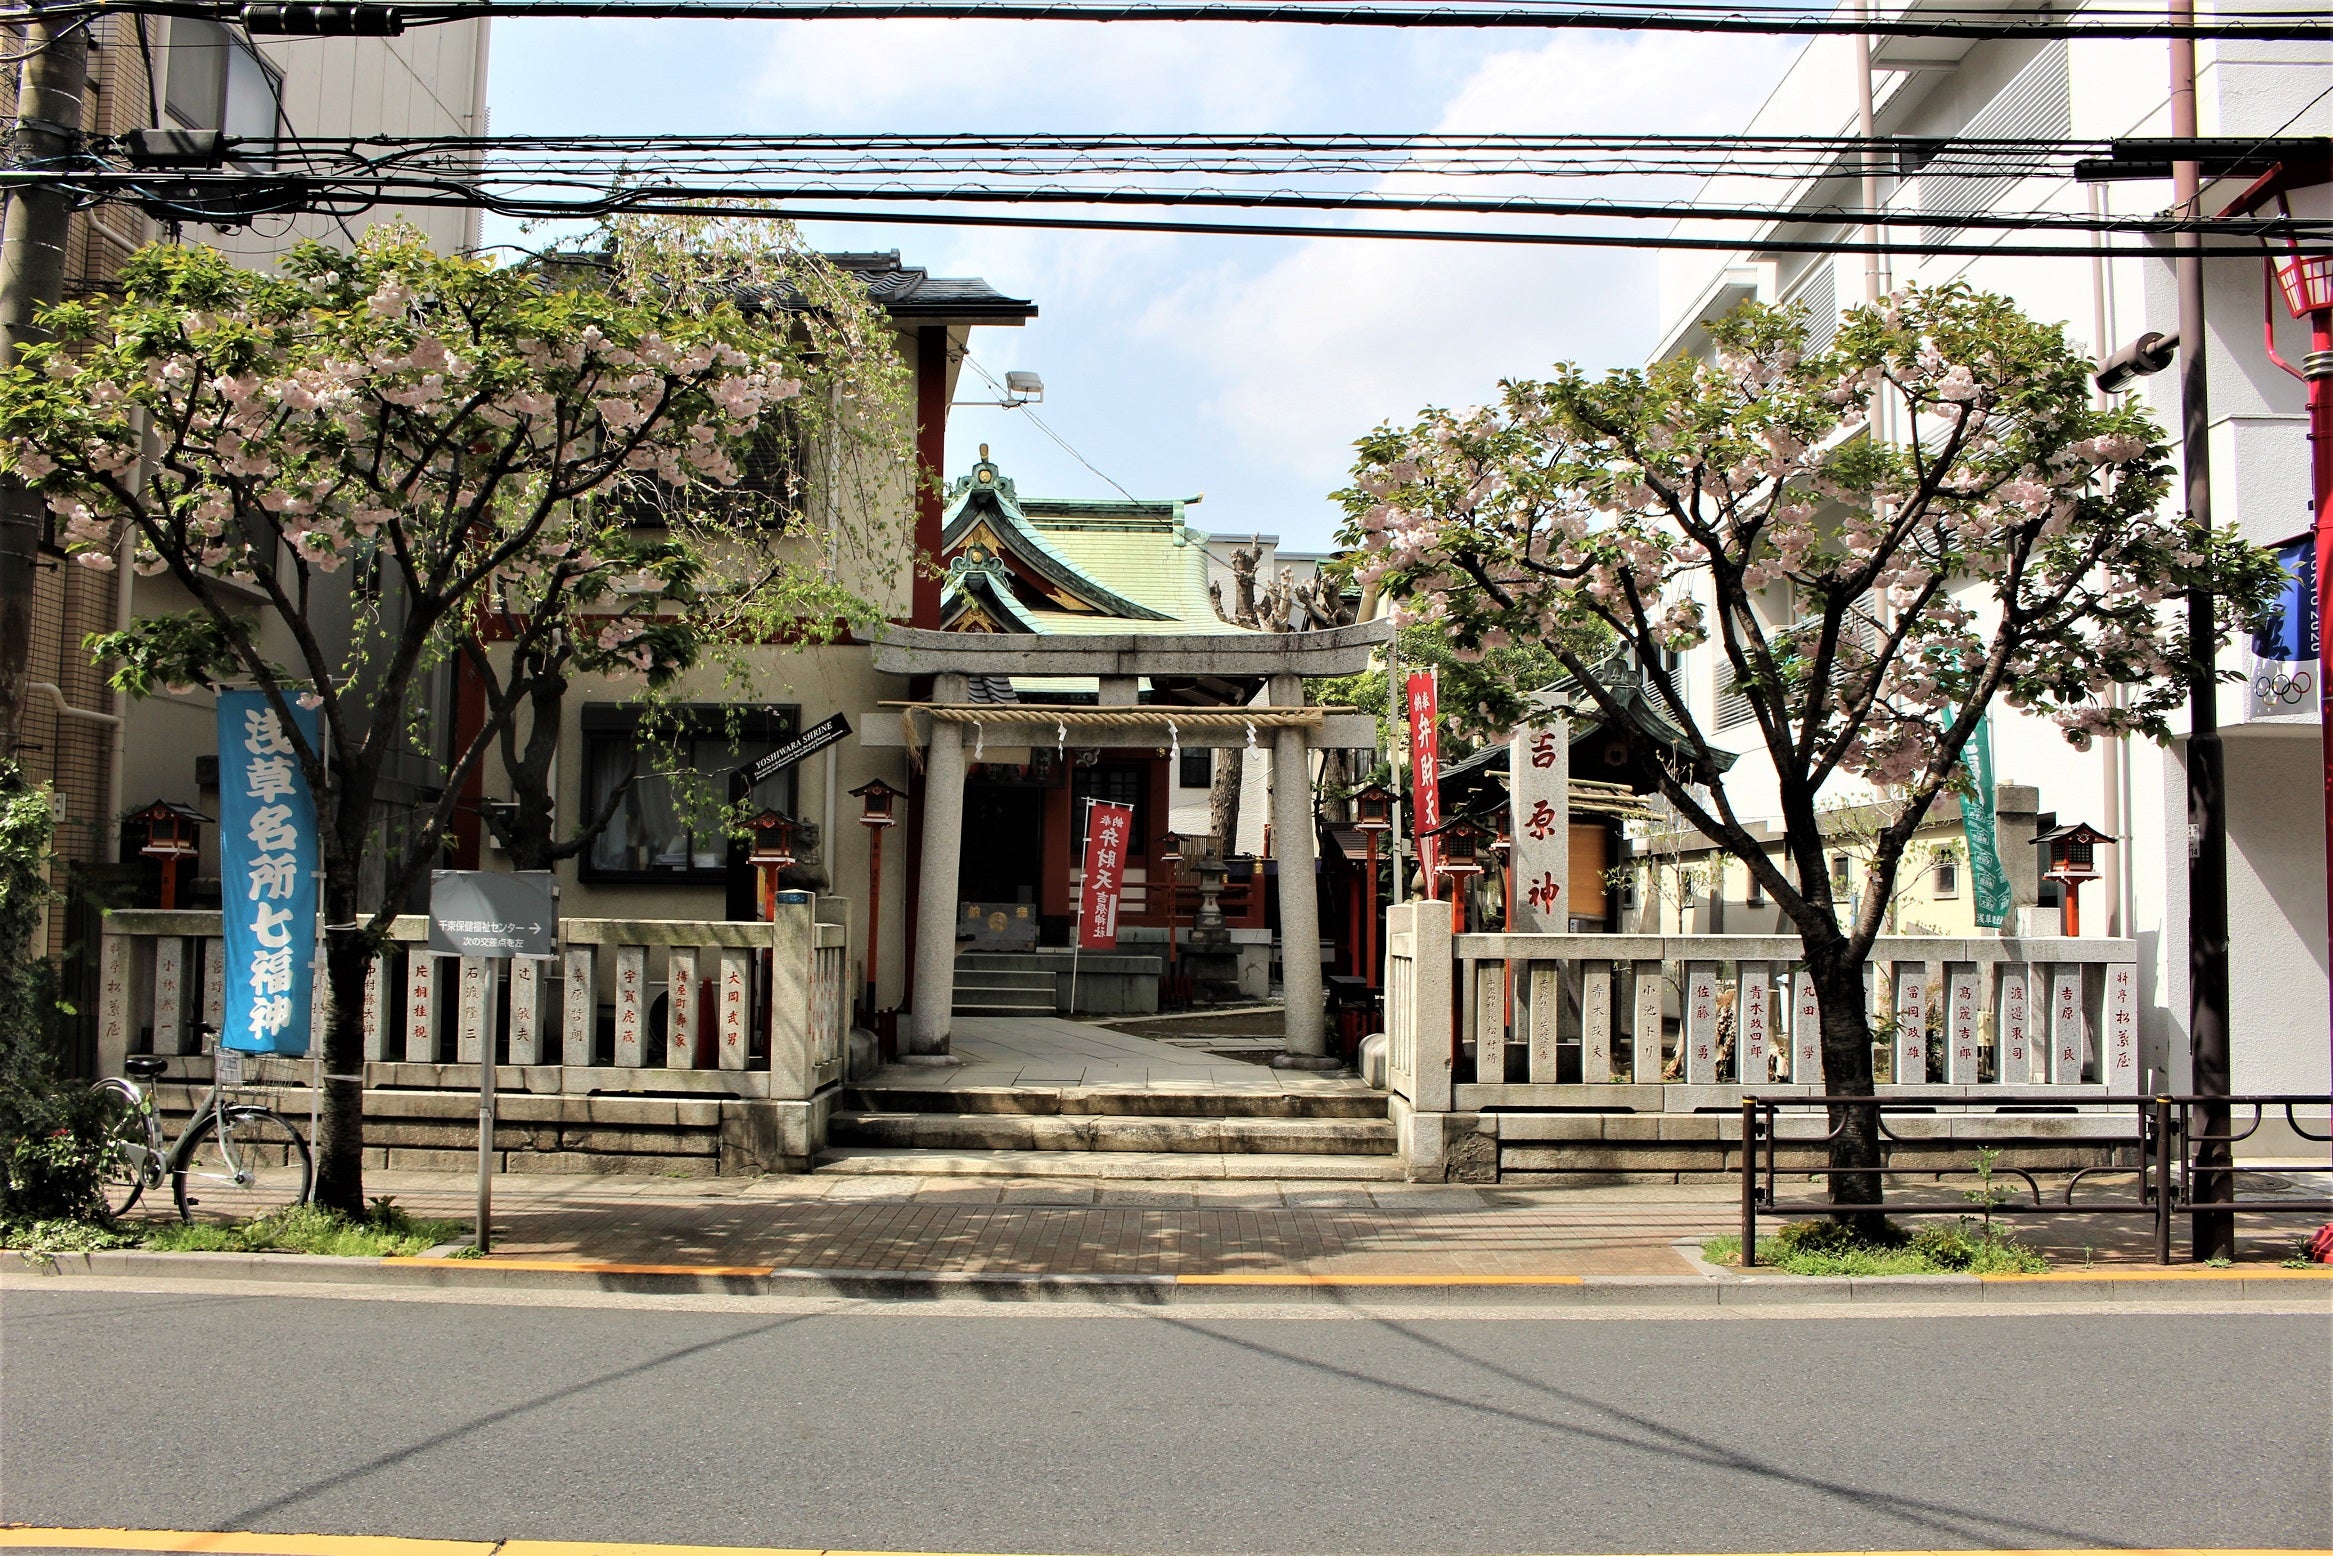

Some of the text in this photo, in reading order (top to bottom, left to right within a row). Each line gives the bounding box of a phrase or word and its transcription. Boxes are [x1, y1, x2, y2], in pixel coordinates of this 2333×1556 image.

[755, 721, 833, 770] YOSHIWARA SHRINE
[1418, 712, 1437, 826] 弁財天
[1524, 733, 1560, 915] 吉原神
[244, 707, 299, 1040] 浅草名所七福神
[438, 920, 525, 933] 千束保健福祉センター
[463, 937, 524, 948] 次の交差点を左
[727, 971, 741, 1046] 大岡武男
[1696, 985, 1710, 1060] 佐藤勇
[1750, 985, 1764, 1059] 青木政四郎
